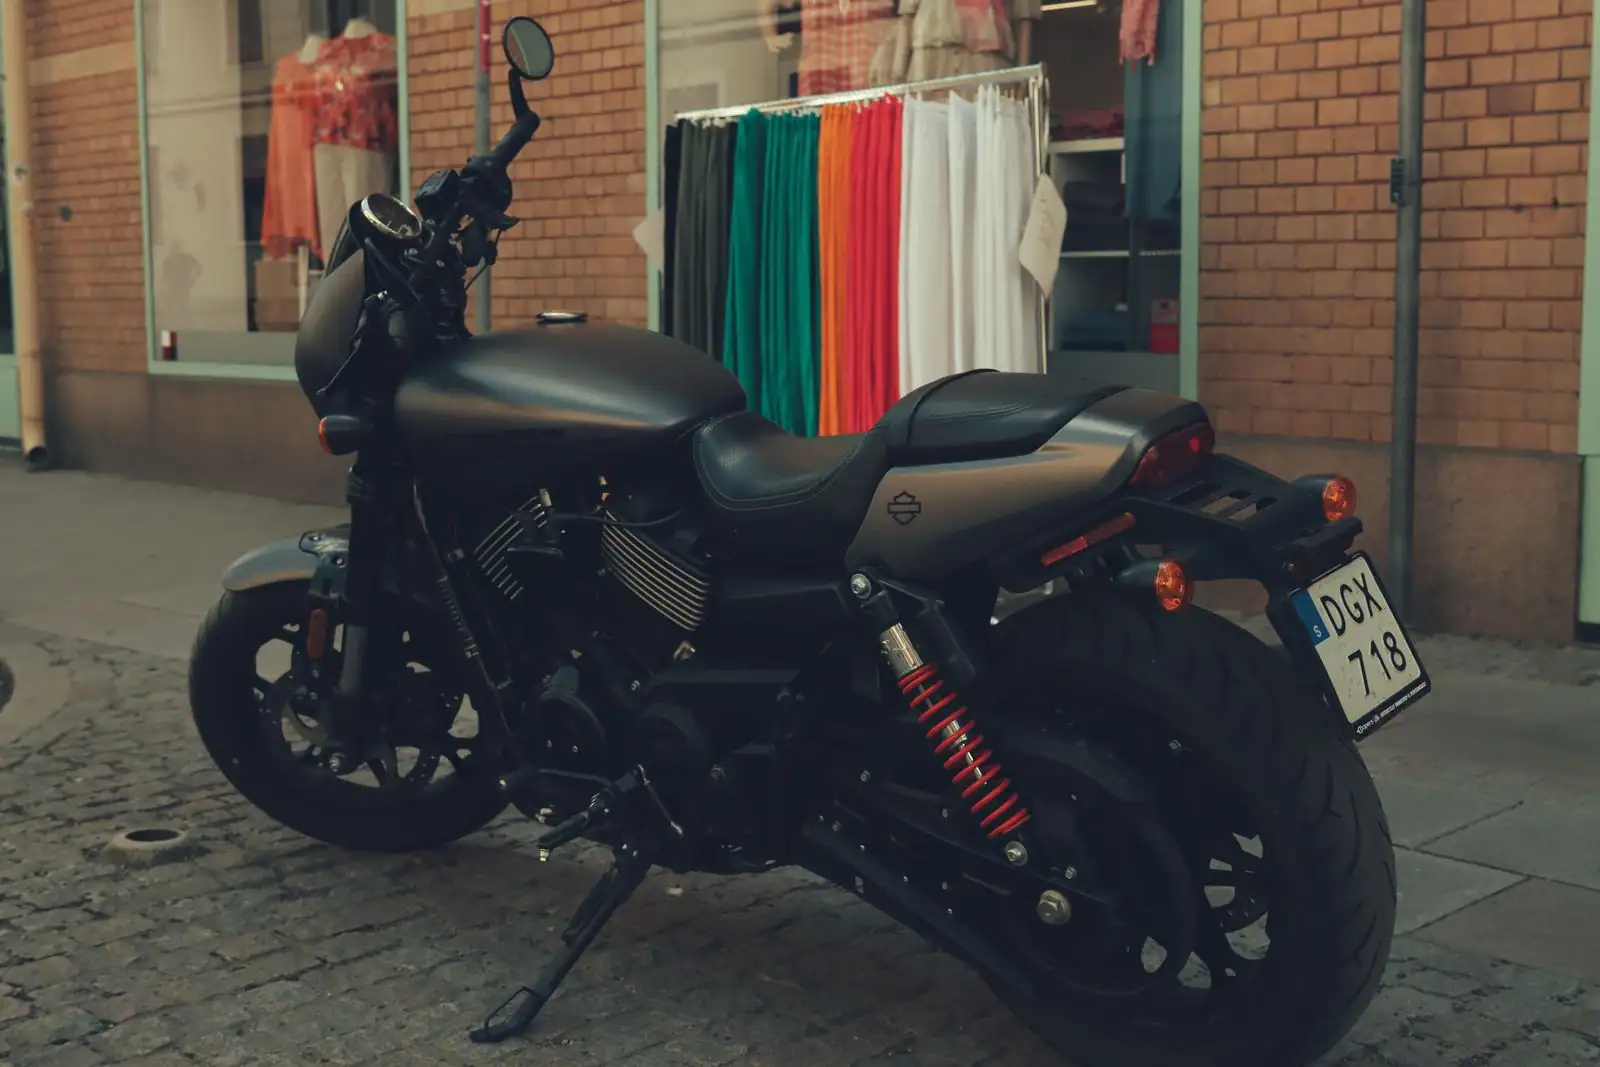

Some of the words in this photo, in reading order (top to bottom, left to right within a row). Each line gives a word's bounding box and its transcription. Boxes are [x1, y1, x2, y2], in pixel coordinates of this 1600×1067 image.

[1312, 624, 1322, 638] S
[1319, 572, 1383, 637] DGX
[1347, 631, 1407, 697] 718
